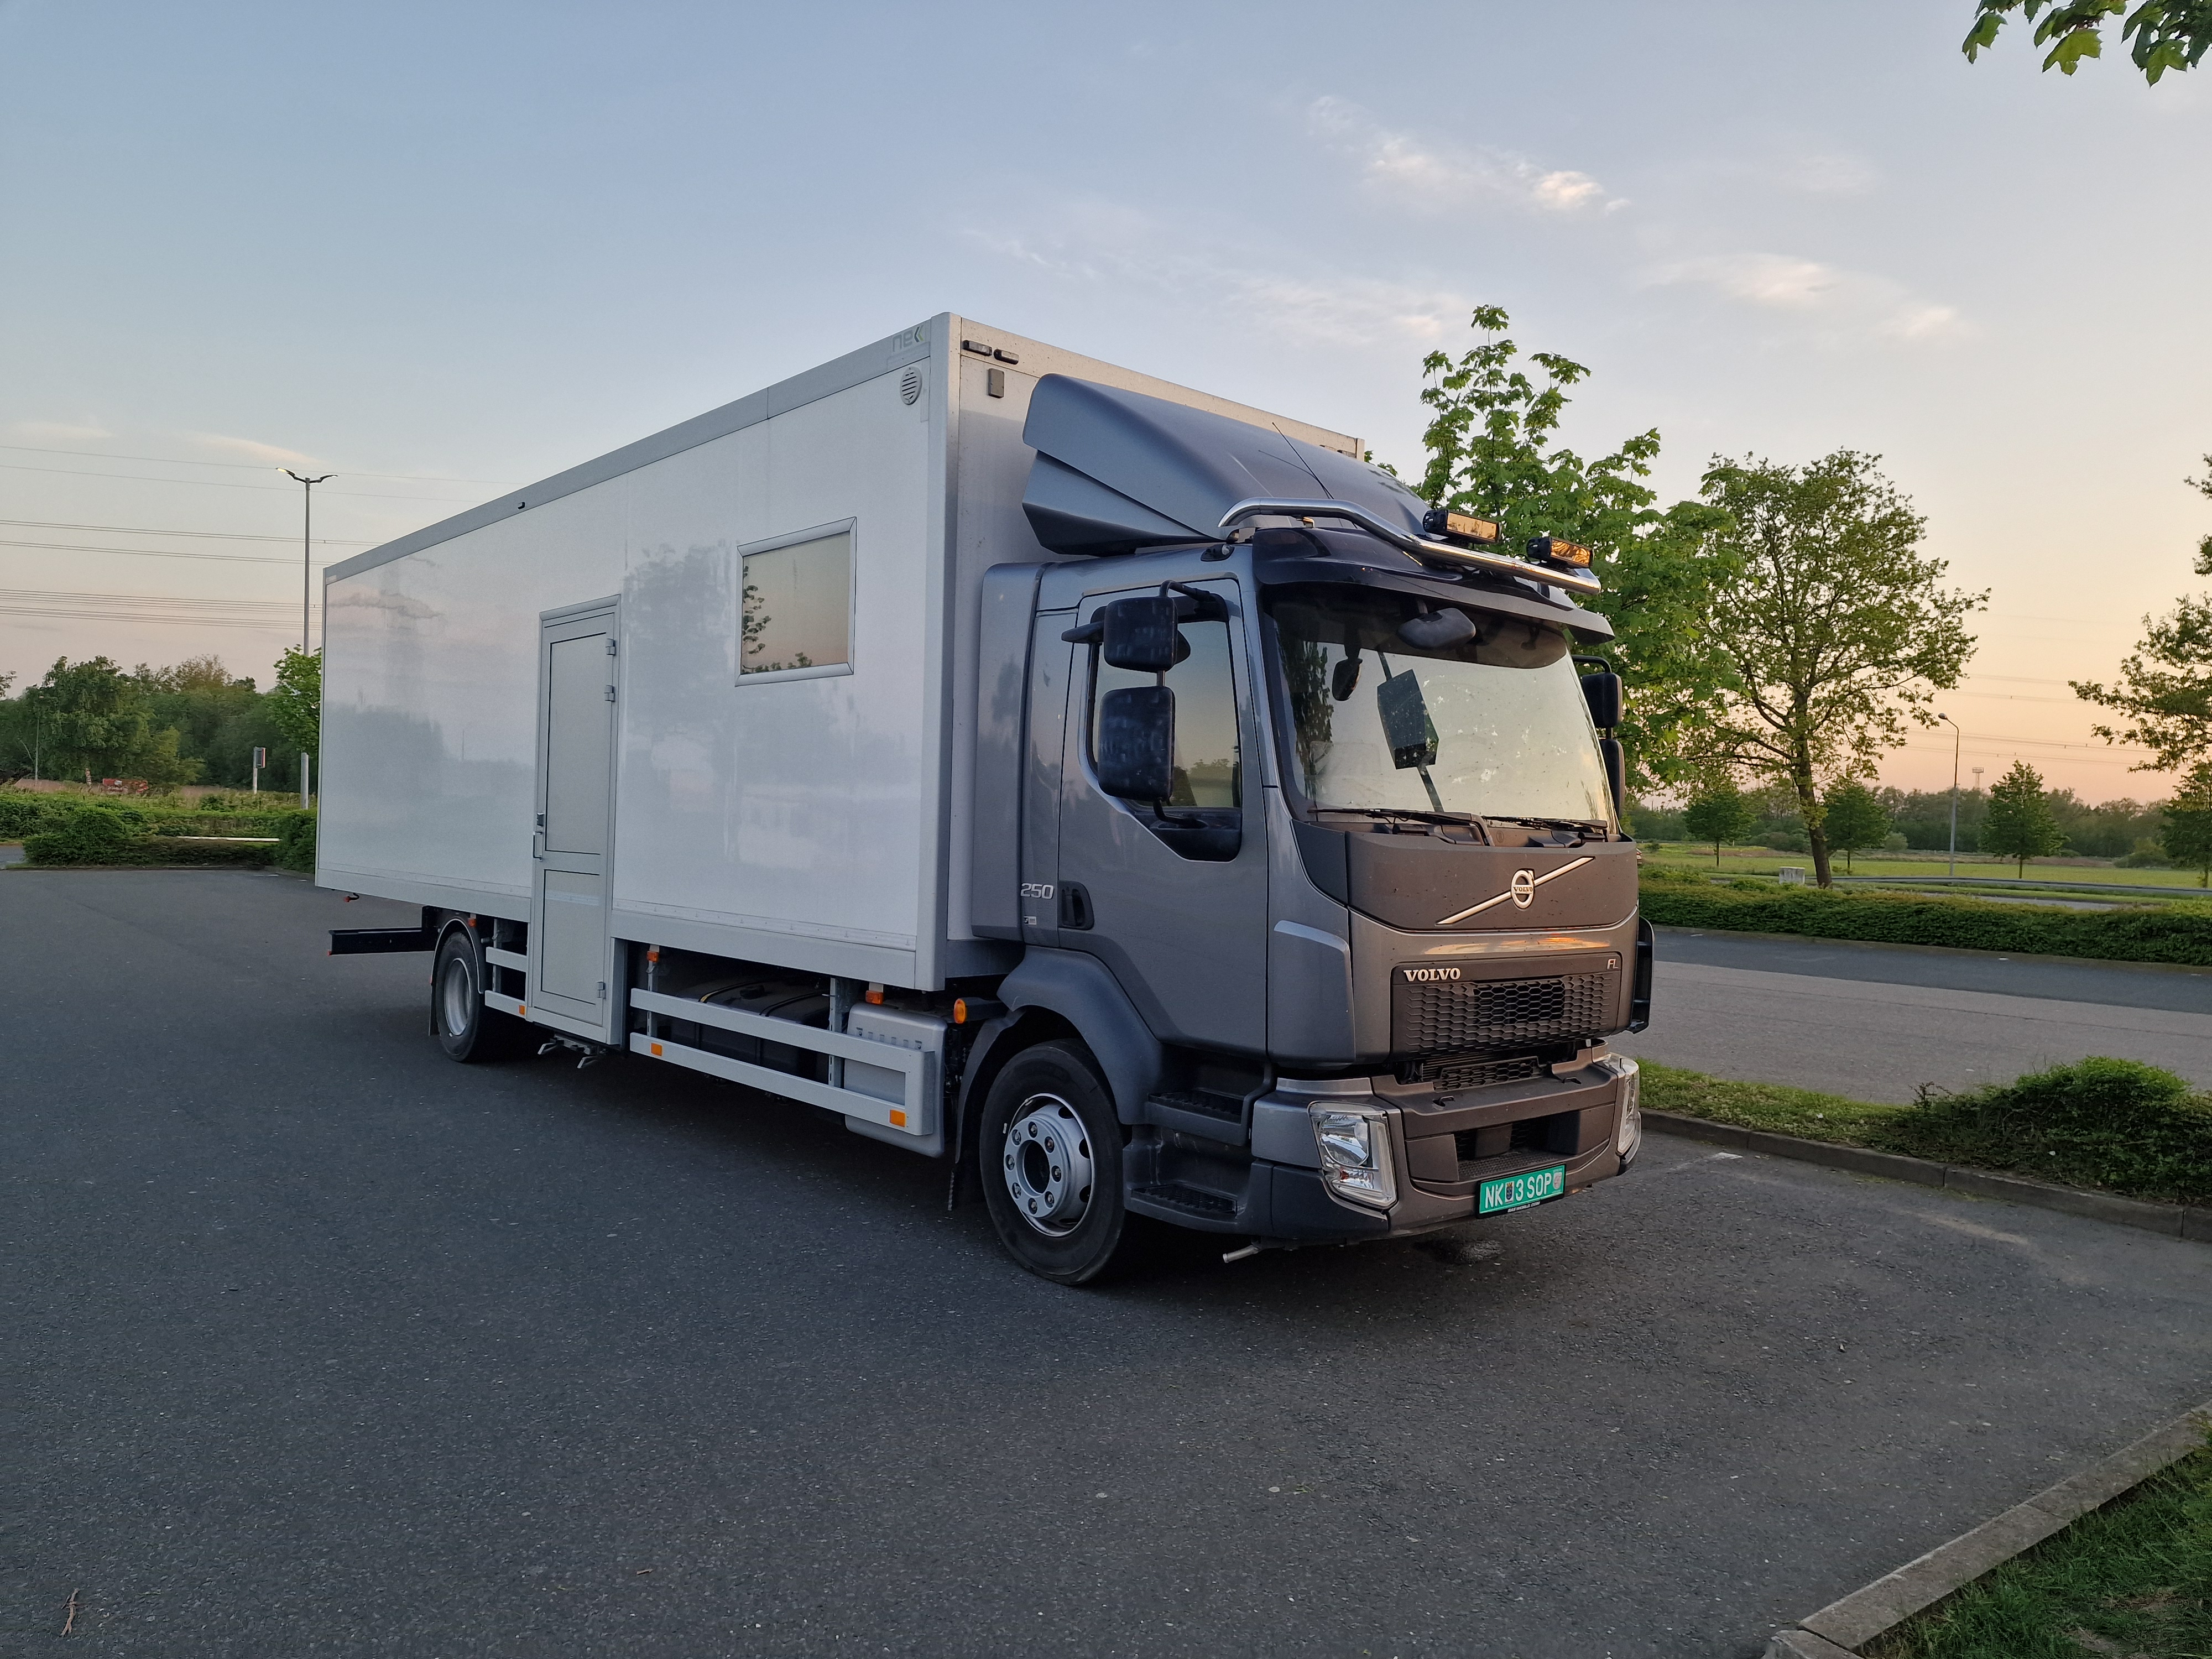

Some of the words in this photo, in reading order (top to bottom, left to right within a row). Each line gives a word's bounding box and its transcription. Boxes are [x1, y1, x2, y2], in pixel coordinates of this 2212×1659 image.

[1020, 883, 1054, 899] 250
[1606, 958, 1619, 969] FL
[1403, 967, 1460, 982] VOLVO
[1485, 1183, 1504, 1209] NK
